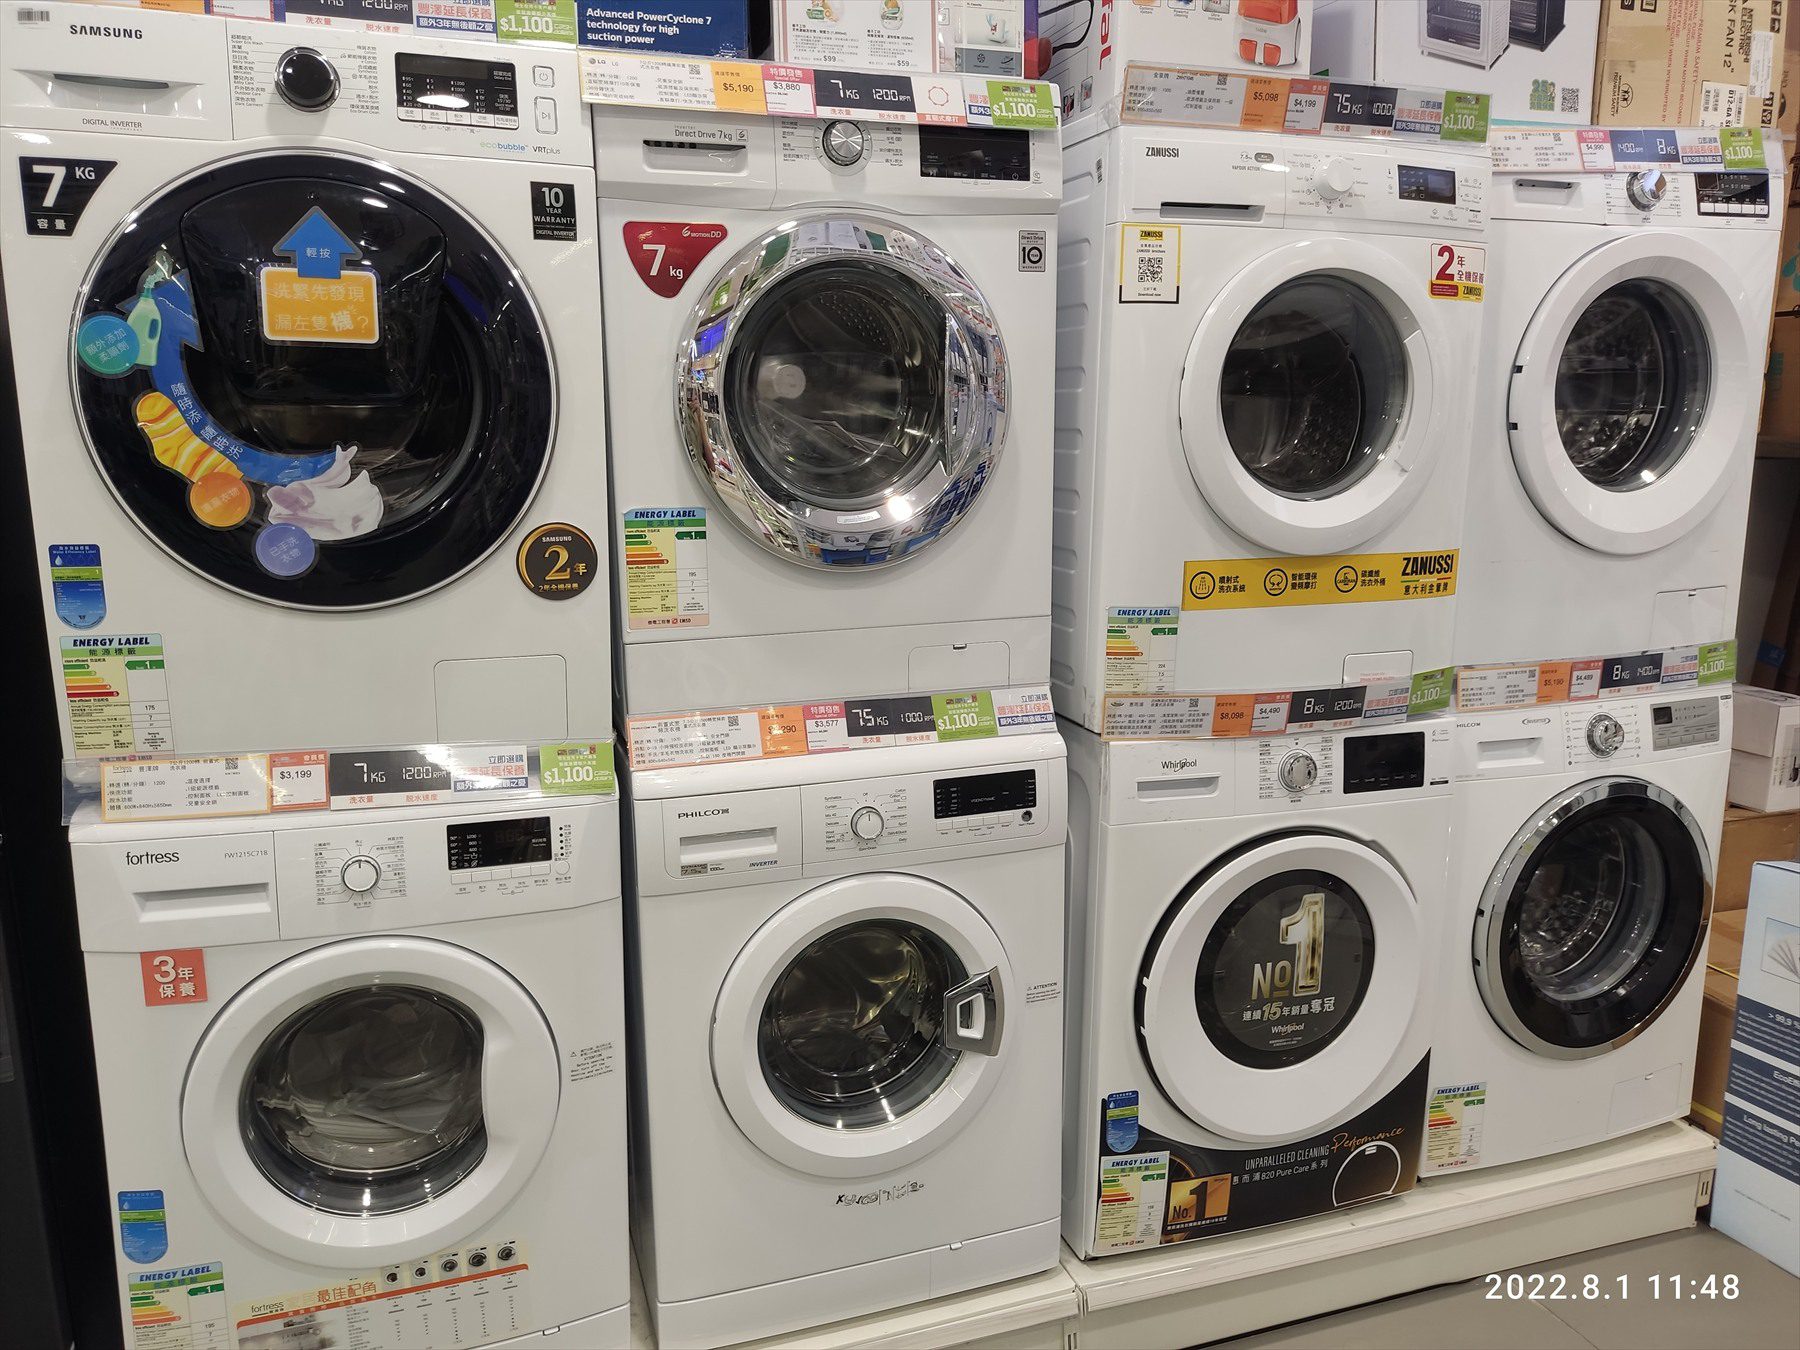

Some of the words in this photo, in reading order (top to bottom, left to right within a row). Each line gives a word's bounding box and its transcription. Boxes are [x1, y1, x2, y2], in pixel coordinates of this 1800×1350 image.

[361, 0, 393, 9] 1200
[394, 3, 409, 11] RPM
[417, 4, 493, 19] 豐澤延長保養
[305, 16, 332, 26] 洗衣量
[586, 8, 634, 21] Advanced
[637, 11, 704, 25] PowerCyclone
[706, 16, 712, 25] 7
[419, 18, 494, 31] 額外3年無後顧之憂
[500, 15, 553, 34] $1,100
[586, 20, 640, 33] technology
[642, 23, 657, 33] for
[659, 25, 680, 36] high
[1738, 7, 1748, 55] ELECTRIC
[70, 25, 143, 39] SAMSUNG
[587, 31, 622, 42] suction
[624, 35, 655, 46] power
[1695, 19, 1704, 54] PREMIUM
[1725, 19, 1736, 48] FAN
[1743, 8, 1754, 63] MITSUBISHI
[770, 67, 803, 78] 特價發售
[1692, 56, 1700, 84] SAFETY
[723, 82, 754, 93] $5,190
[773, 81, 800, 91] $3,880
[830, 79, 844, 99] 7
[845, 89, 860, 100] KG
[872, 88, 898, 102] 1200
[1253, 91, 1279, 102] $5,098
[1293, 98, 1317, 108] $4,199
[831, 108, 852, 116] 洗衣量
[993, 102, 1036, 118] $1,100
[1351, 104, 1362, 115] KG
[1372, 102, 1393, 116] 1000
[82, 118, 108, 126] DIGITAL
[110, 120, 142, 128] INVERTER
[1444, 114, 1475, 131] $1,100
[674, 129, 696, 137] Direct
[697, 130, 717, 139] Drive
[480, 142, 526, 150] ecobubble
[1146, 147, 1179, 158] ZANUSSI
[1724, 146, 1753, 160] $1,100
[32, 164, 66, 208] 7
[75, 167, 95, 180] KG
[541, 187, 564, 208] 10
[36, 218, 67, 230] 容量
[534, 215, 576, 224] WARRANTY
[1140, 231, 1163, 239] ZANUSSI
[306, 247, 332, 259] 輕按
[1022, 246, 1042, 264] 10
[643, 244, 666, 276] 7
[670, 266, 683, 279] kg
[1462, 286, 1481, 297] ZANUSSI
[634, 510, 669, 519] ENERGY
[670, 510, 697, 518] LABEL
[542, 535, 572, 543] SAMSUNG
[544, 544, 588, 582] 2年
[1401, 554, 1454, 577] ZANUSSI
[1403, 582, 1449, 596] 意大利金章牌
[73, 638, 114, 648] ENERGY
[118, 637, 150, 646] LABEL
[1613, 665, 1621, 680] 8
[1700, 659, 1724, 675] $1,100
[1412, 688, 1440, 704] $1,100
[1259, 707, 1280, 715] $4,490
[1303, 698, 1315, 714] 8
[1314, 704, 1325, 713] KG
[1334, 700, 1353, 711] 1200
[876, 716, 889, 726] KG
[900, 712, 923, 723] 1000
[938, 713, 977, 731] $1,100
[1220, 712, 1245, 720] $8,098
[814, 719, 839, 728] $3,577
[1161, 758, 1197, 772] Whirlpool
[279, 770, 312, 780] $3,199
[354, 762, 368, 783] 7
[370, 772, 386, 783] KG
[402, 767, 432, 780] 1200
[433, 771, 448, 779] RPM
[544, 766, 592, 785] $1,100
[349, 795, 374, 804] 洗衣量
[678, 809, 721, 819] PHILCO
[126, 851, 180, 866] fortress
[749, 860, 778, 868] INVERTER
[1279, 893, 1325, 997] 1
[153, 956, 194, 983] 3年
[159, 982, 196, 999] 保養
[1033, 982, 1057, 990] ATTENTION
[1775, 1014, 1792, 1026] 99.9
[1271, 1023, 1304, 1035] Whirlpool
[1743, 1115, 1762, 1131] Long
[1762, 1123, 1789, 1143] lasting
[1245, 1154, 1296, 1170] UNPARALLELED
[1297, 1145, 1330, 1161] CLEANING
[1331, 1127, 1405, 1153] Performance
[1112, 1158, 1138, 1167] ENERGY
[1139, 1157, 1160, 1165] LABEL
[1261, 1171, 1275, 1181] 820
[1276, 1168, 1291, 1178] Pure
[1293, 1165, 1309, 1175] Care
[1310, 1159, 1329, 1171] 系列
[1172, 1205, 1192, 1220] No.
[1190, 1181, 1209, 1220] 1
[139, 1270, 177, 1282] ENERGY
[181, 1265, 212, 1277] LABEL
[316, 1281, 378, 1303] 最佳配角
[251, 1301, 284, 1314] fortress
